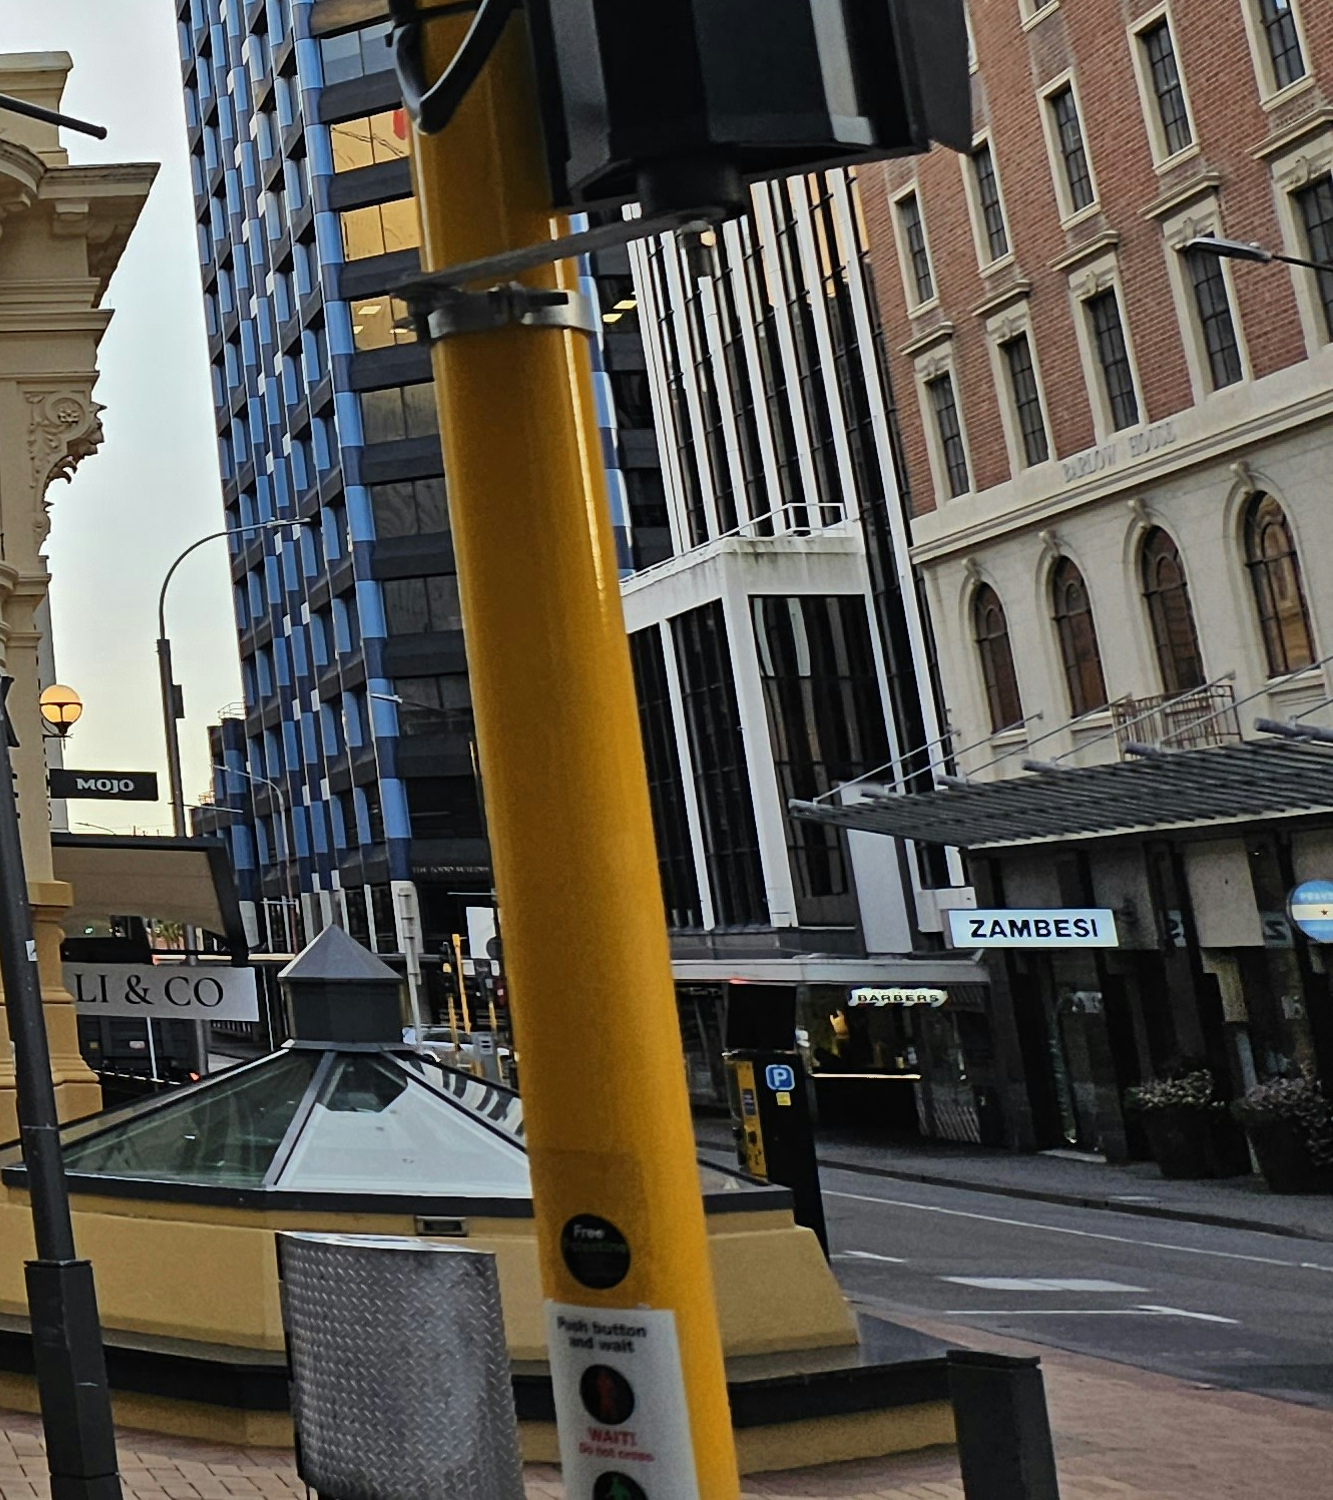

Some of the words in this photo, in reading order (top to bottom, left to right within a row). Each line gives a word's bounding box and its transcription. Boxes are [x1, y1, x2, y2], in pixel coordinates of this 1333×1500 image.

[75, 778, 135, 794] MOJO
[969, 918, 1099, 938] ZAMBESI
[124, 974, 155, 1006] &
[164, 976, 225, 1008] CO
[858, 994, 940, 1003] BARBERS
[573, 1224, 605, 1239] Free
[557, 1315, 589, 1333] Push
[593, 1321, 647, 1338] button
[569, 1336, 594, 1350] and
[599, 1340, 635, 1353] wait
